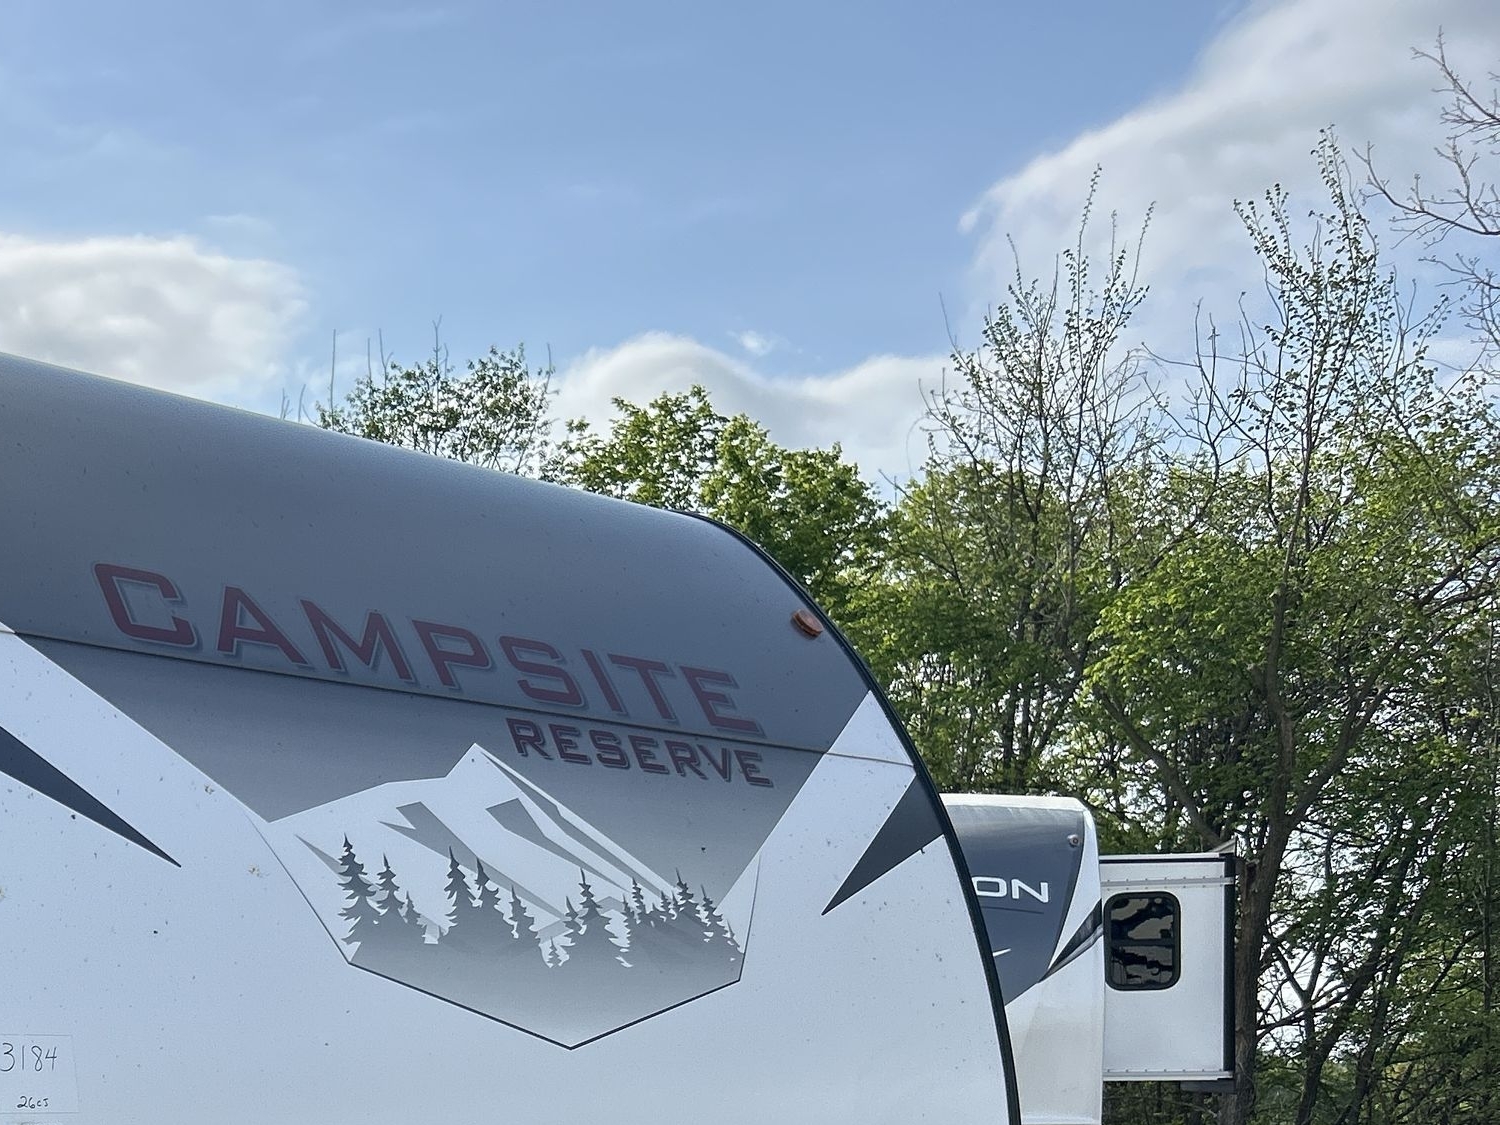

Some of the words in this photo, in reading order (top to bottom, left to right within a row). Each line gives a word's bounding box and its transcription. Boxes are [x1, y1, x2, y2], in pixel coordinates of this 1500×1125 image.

[92, 562, 764, 737] CAMPSITE
[504, 716, 775, 787] RESERVE
[0, 1042, 58, 1072] 3184
